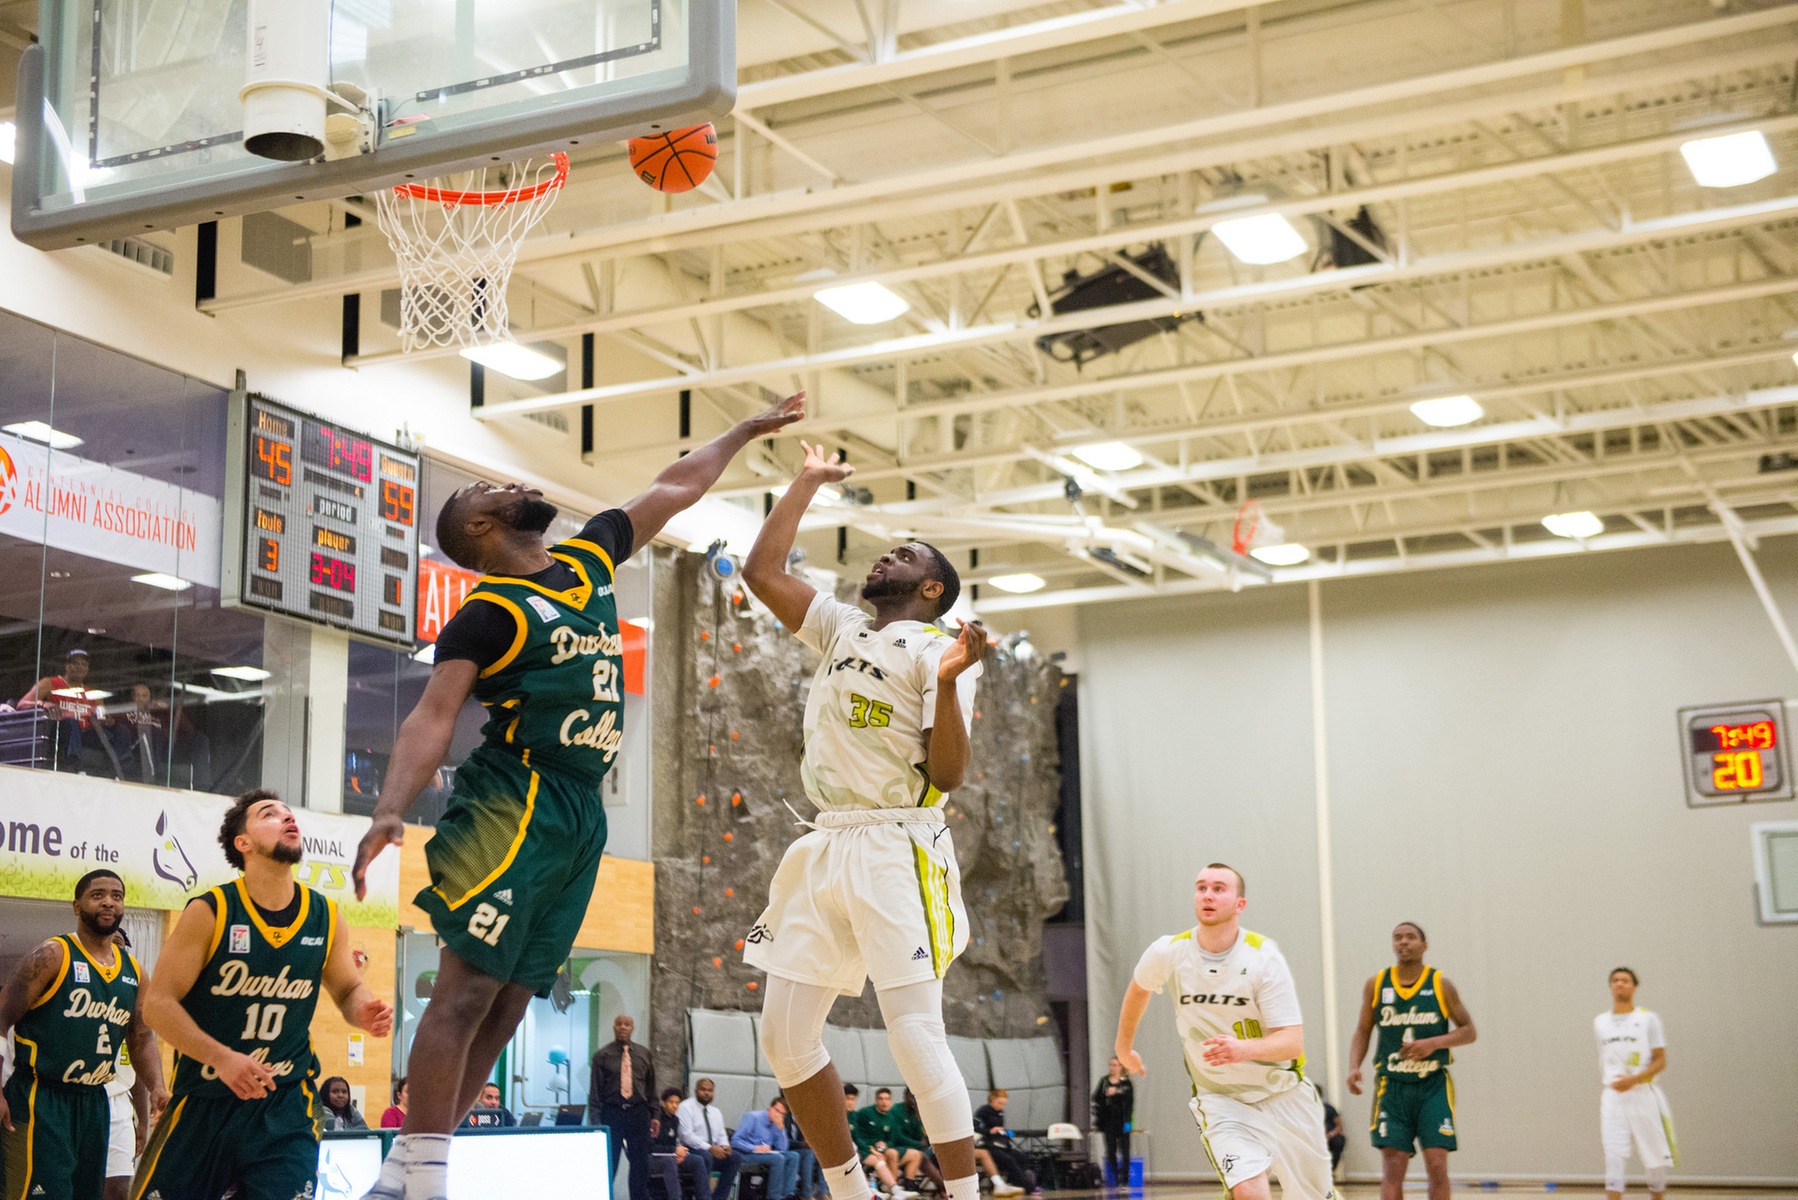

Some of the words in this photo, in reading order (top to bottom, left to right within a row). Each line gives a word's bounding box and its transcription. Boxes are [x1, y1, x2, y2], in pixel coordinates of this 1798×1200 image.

[259, 411, 287, 437] Home
[258, 437, 291, 486] 45
[320, 427, 372, 483] 7:49
[28, 465, 124, 503] CENTENNIAL
[136, 495, 196, 524] COLLEGE
[320, 498, 352, 522] period
[384, 480, 415, 527] 59
[24, 479, 87, 524] ALUMNI
[93, 499, 196, 552] ASSOCIATION
[265, 539, 279, 572] 3
[317, 527, 350, 552] player
[311, 552, 355, 592] 3-04
[396, 578, 402, 606] 1
[592, 659, 620, 702] 21
[848, 693, 893, 728] 35
[559, 708, 623, 763] Colleg
[1711, 720, 1776, 750] 7:49
[1713, 750, 1764, 791] 20
[0, 820, 62, 857] me
[70, 842, 87, 859] of
[95, 844, 119, 862] the
[302, 836, 345, 858] NNIAL
[467, 902, 510, 947] 21
[1180, 994, 1250, 1006] COLTS
[1379, 1005, 1439, 1028] Durham
[96, 1023, 112, 1055] 2
[241, 1003, 287, 1042] 10
[1232, 1018, 1262, 1040] 10
